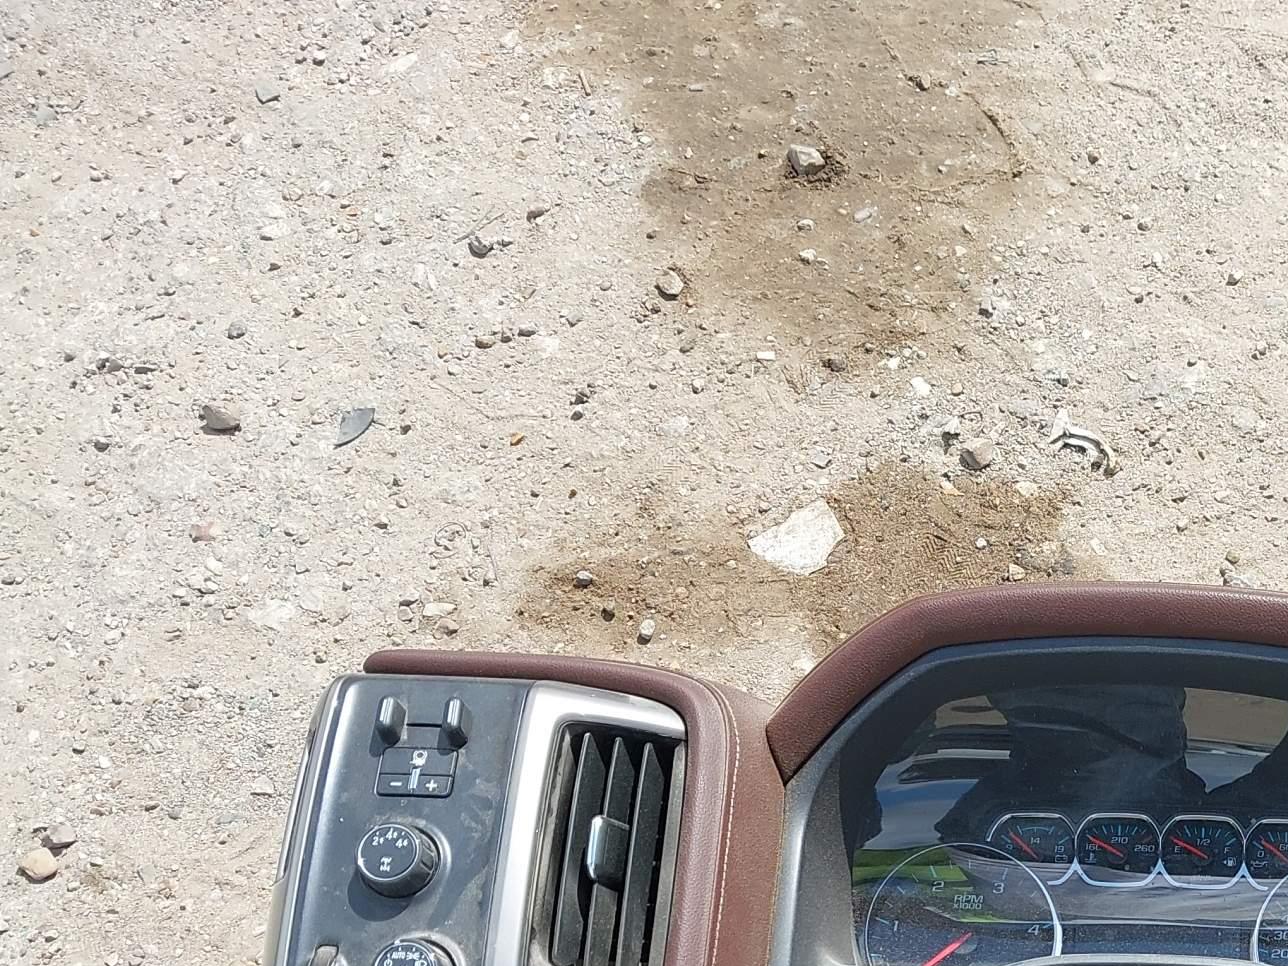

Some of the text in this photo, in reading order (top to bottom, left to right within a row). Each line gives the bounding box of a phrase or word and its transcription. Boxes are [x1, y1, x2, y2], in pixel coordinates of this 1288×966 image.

[932, 881, 944, 892] 2
[992, 883, 1004, 893] 3
[954, 895, 984, 903] RPM
[1027, 924, 1041, 935] 4
